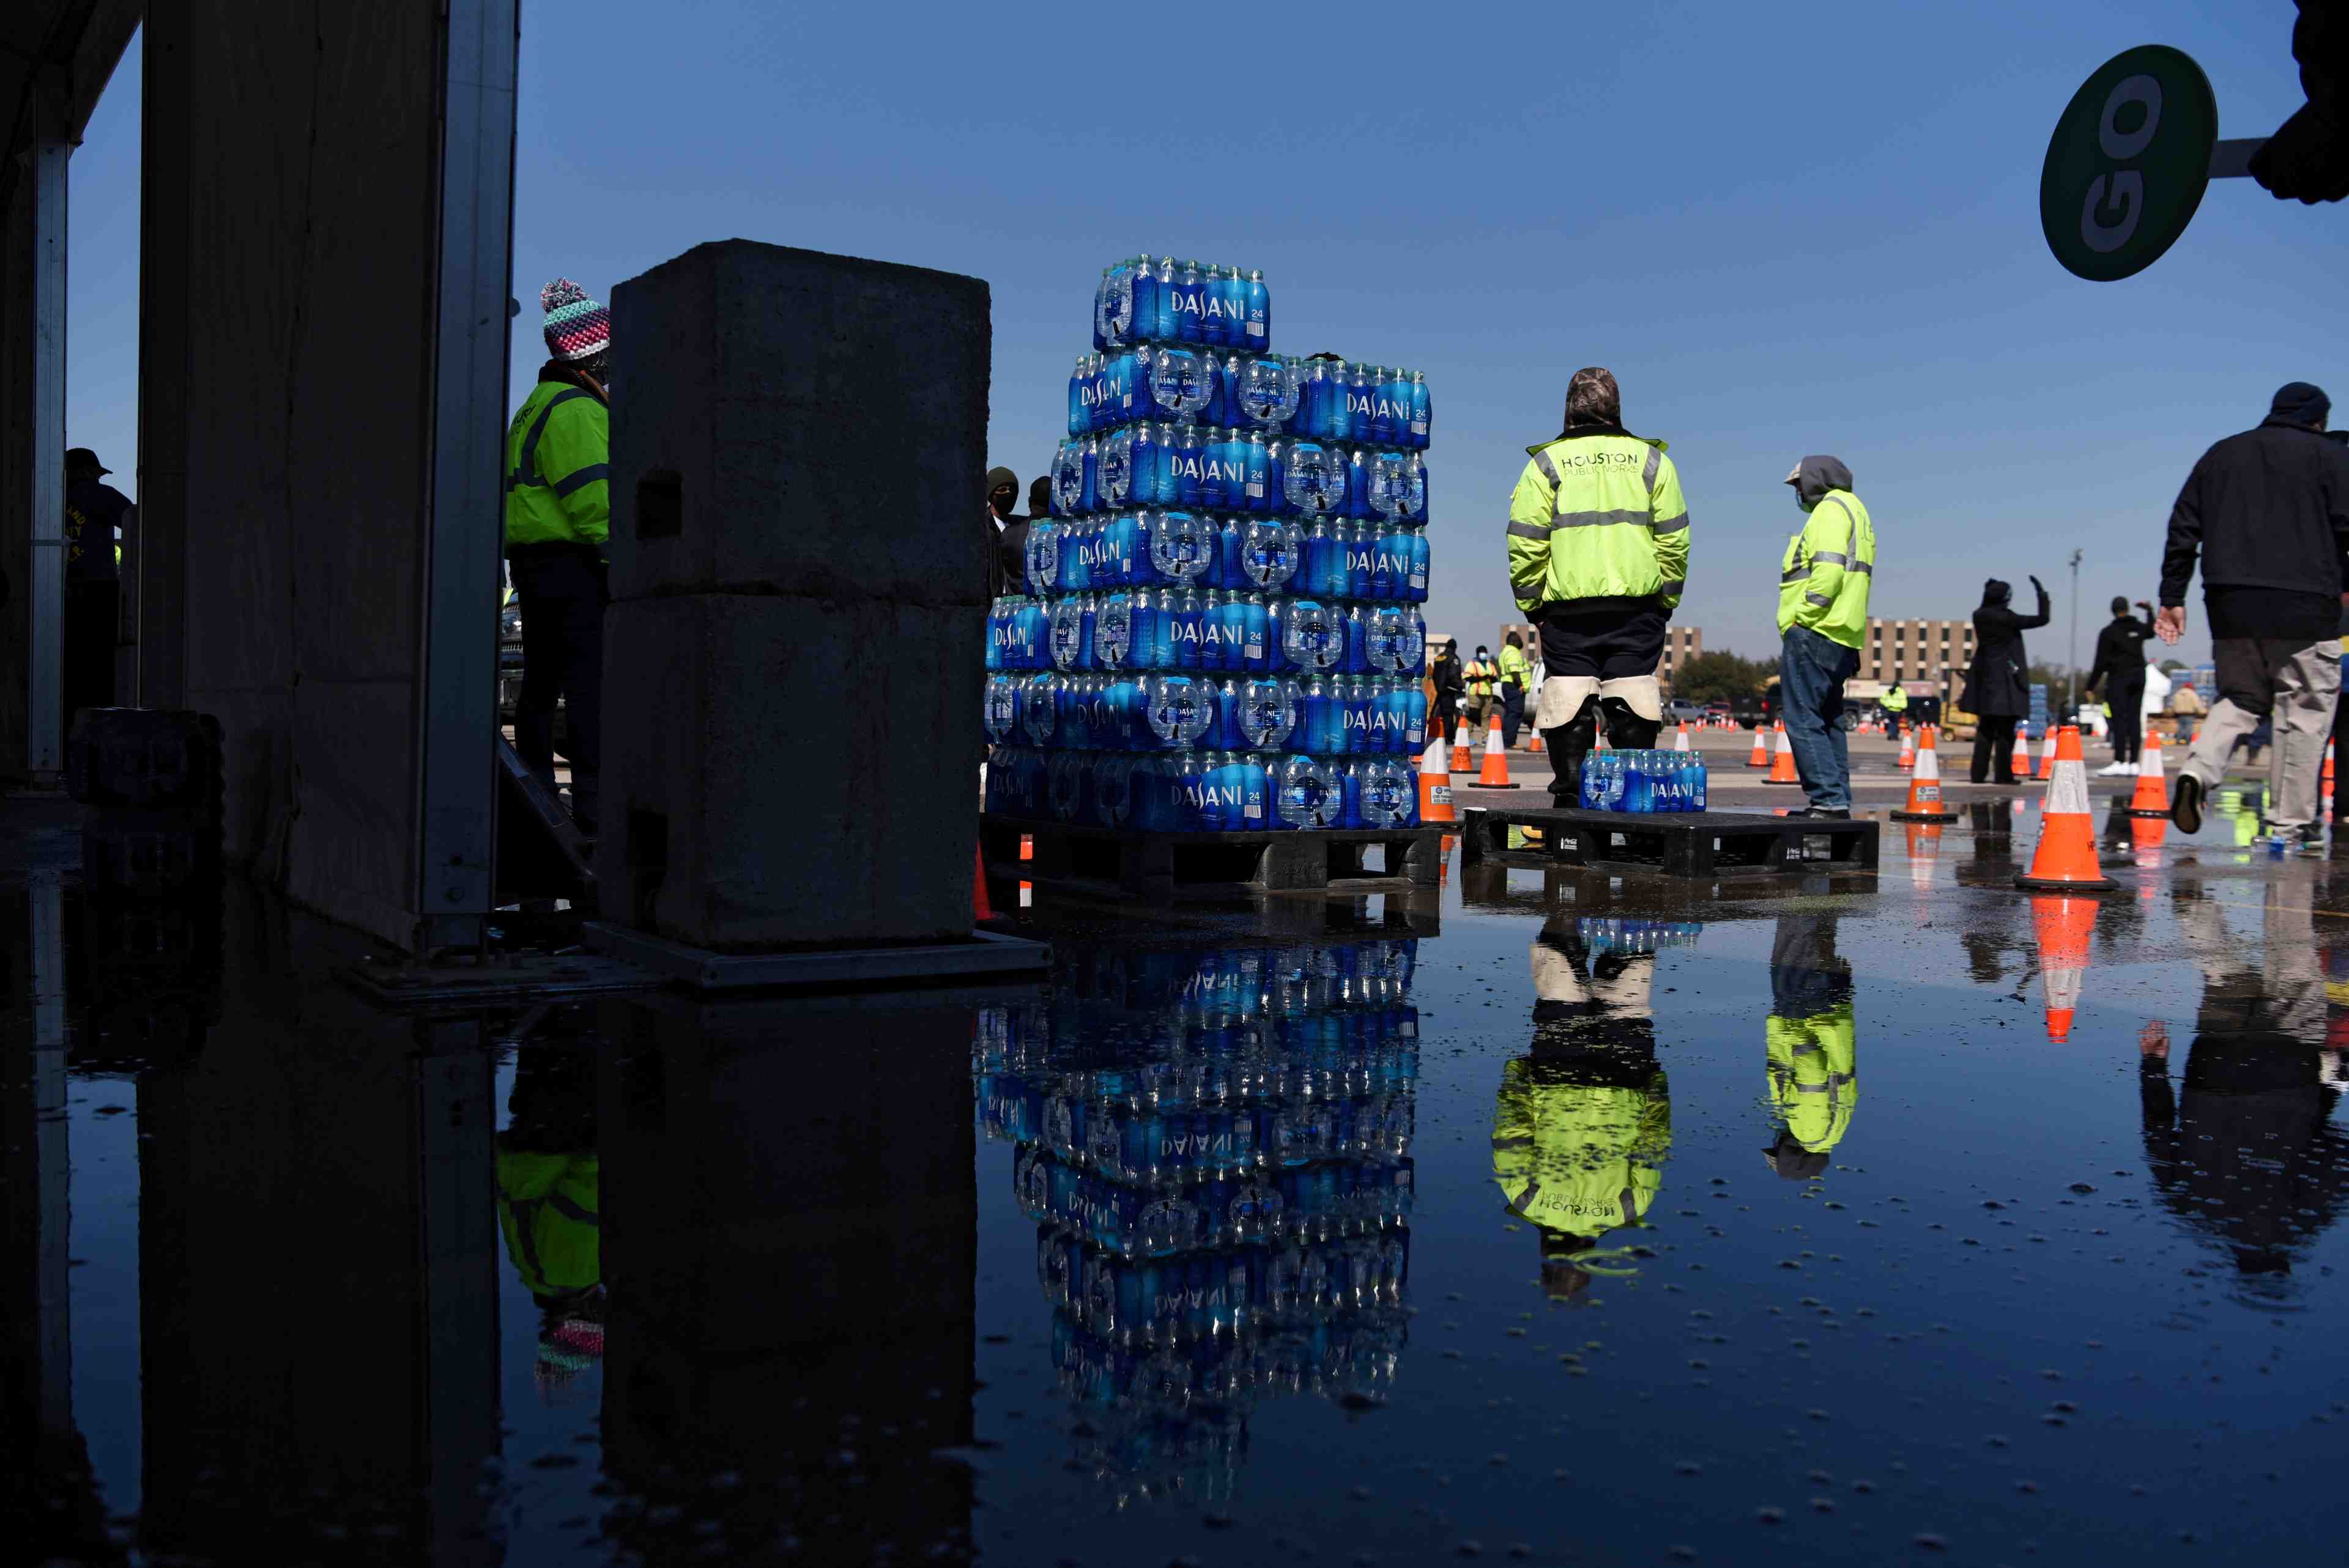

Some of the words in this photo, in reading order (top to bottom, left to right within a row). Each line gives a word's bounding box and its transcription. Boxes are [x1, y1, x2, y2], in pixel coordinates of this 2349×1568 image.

[2080, 73, 2163, 253] GO
[1171, 291, 1244, 321] DASANI
[1251, 309, 1263, 319] 24
[1346, 393, 1410, 421] DASANI
[1171, 455, 1244, 485] DASANI
[1562, 453, 1638, 469] HOUSTON
[1252, 470, 1263, 479] 24
[1347, 548, 1409, 577] DASANI
[1415, 562, 1425, 571] 24
[1171, 618, 1242, 648] DASANI
[1250, 632, 1262, 641] 24
[1343, 705, 1406, 735] DASANI
[1411, 718, 1422, 727] 24
[1171, 780, 1242, 811] DASANI
[1249, 792, 1260, 801] 24
[1651, 779, 1693, 801] DASANI
